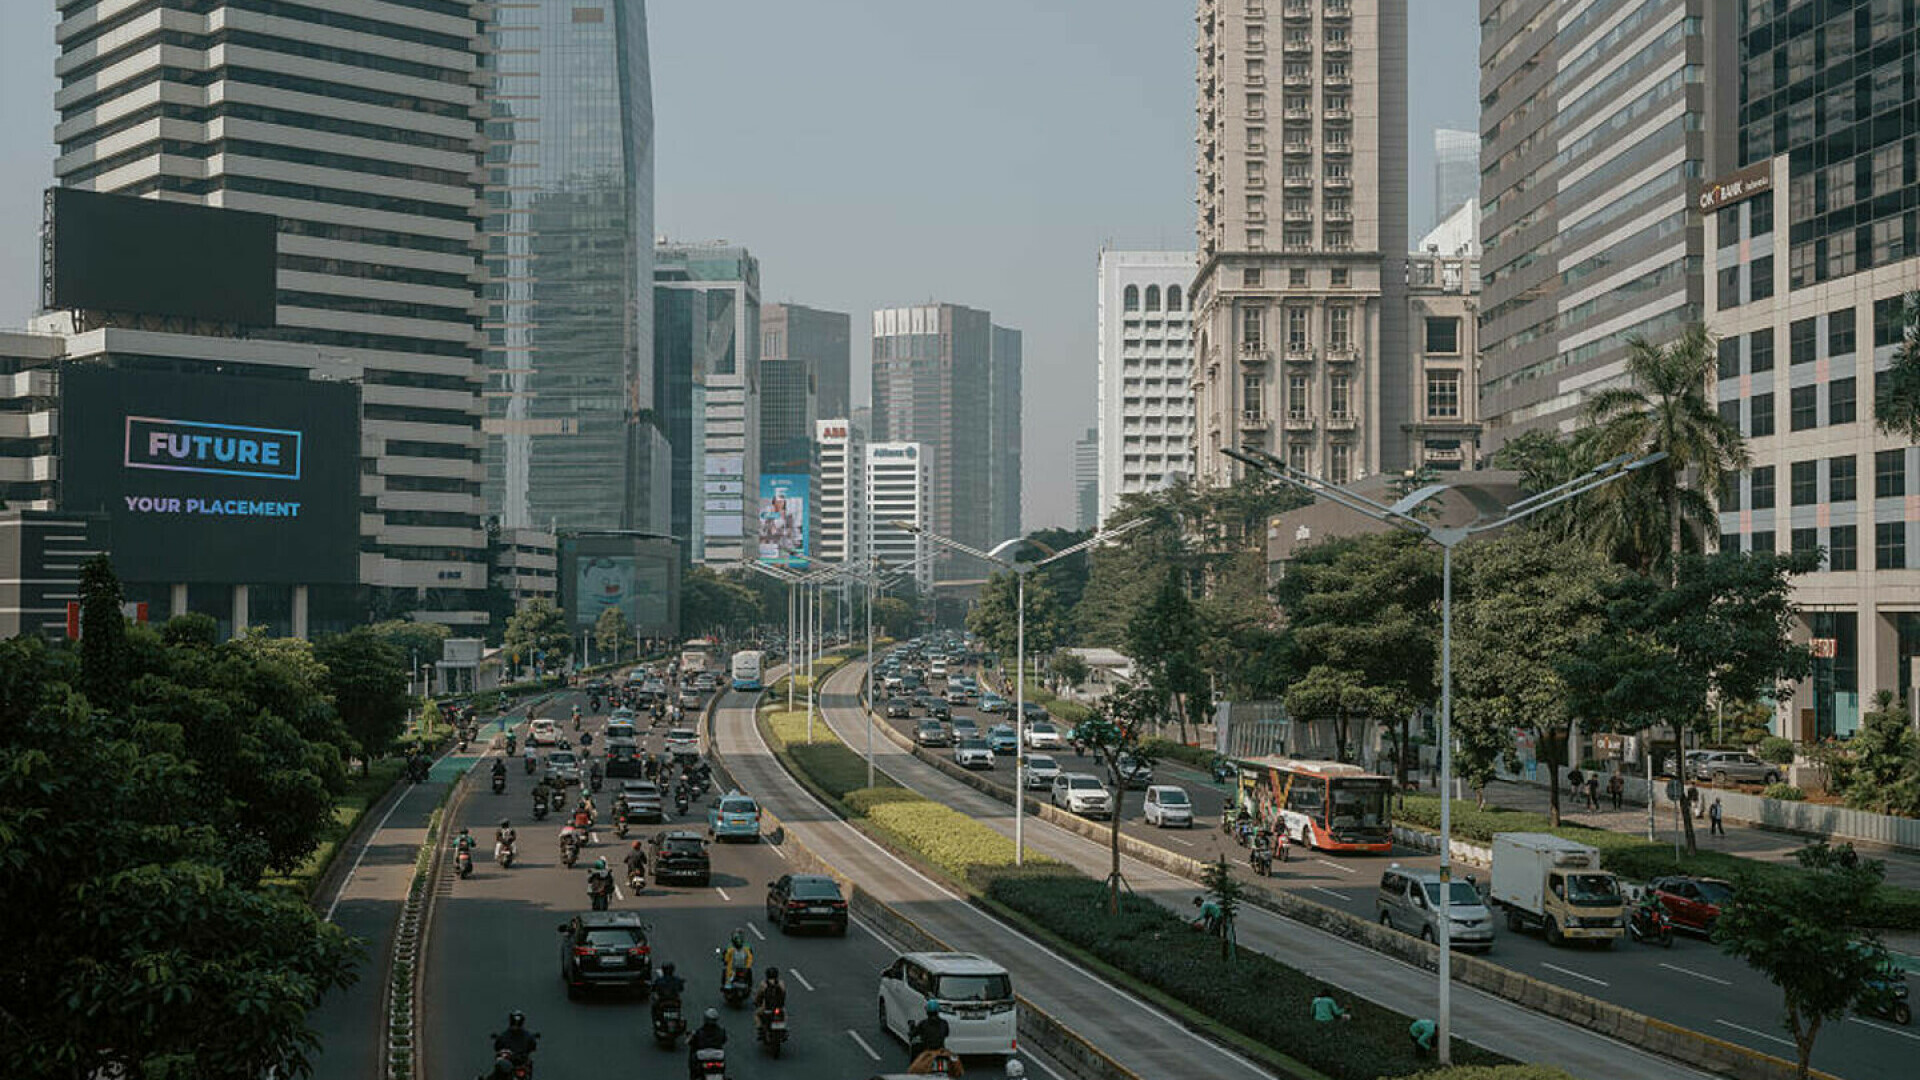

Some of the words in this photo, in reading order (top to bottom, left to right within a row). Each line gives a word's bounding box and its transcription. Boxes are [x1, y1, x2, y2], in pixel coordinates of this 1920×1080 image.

[823, 427, 846, 438] ABB
[149, 431, 280, 465] FUTURE
[125, 496, 181, 513] YOUR
[187, 500, 300, 517] PLACEMENT
